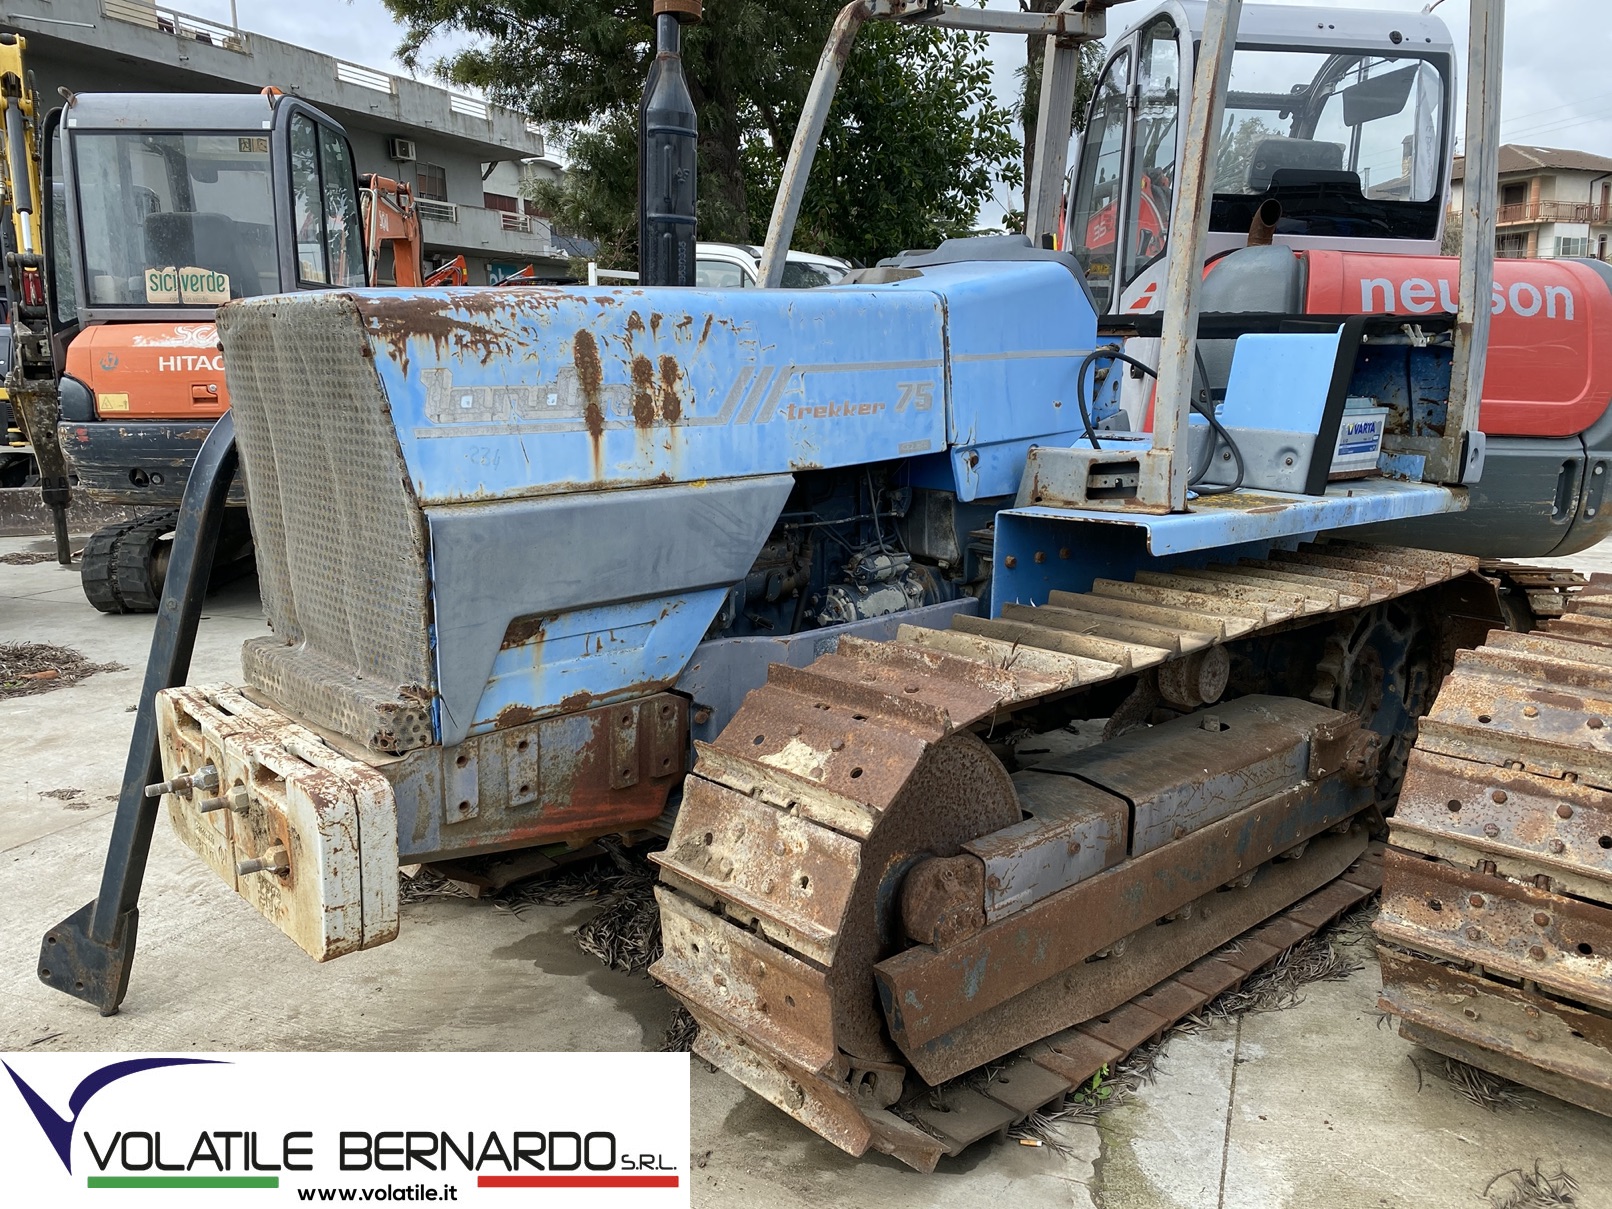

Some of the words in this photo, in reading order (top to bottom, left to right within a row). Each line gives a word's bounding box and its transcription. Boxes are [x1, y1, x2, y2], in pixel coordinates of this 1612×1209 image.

[158, 355, 226, 372] HITAC
[786, 400, 886, 420] trekker
[895, 380, 935, 413] 75
[1354, 421, 1376, 435] VARTA
